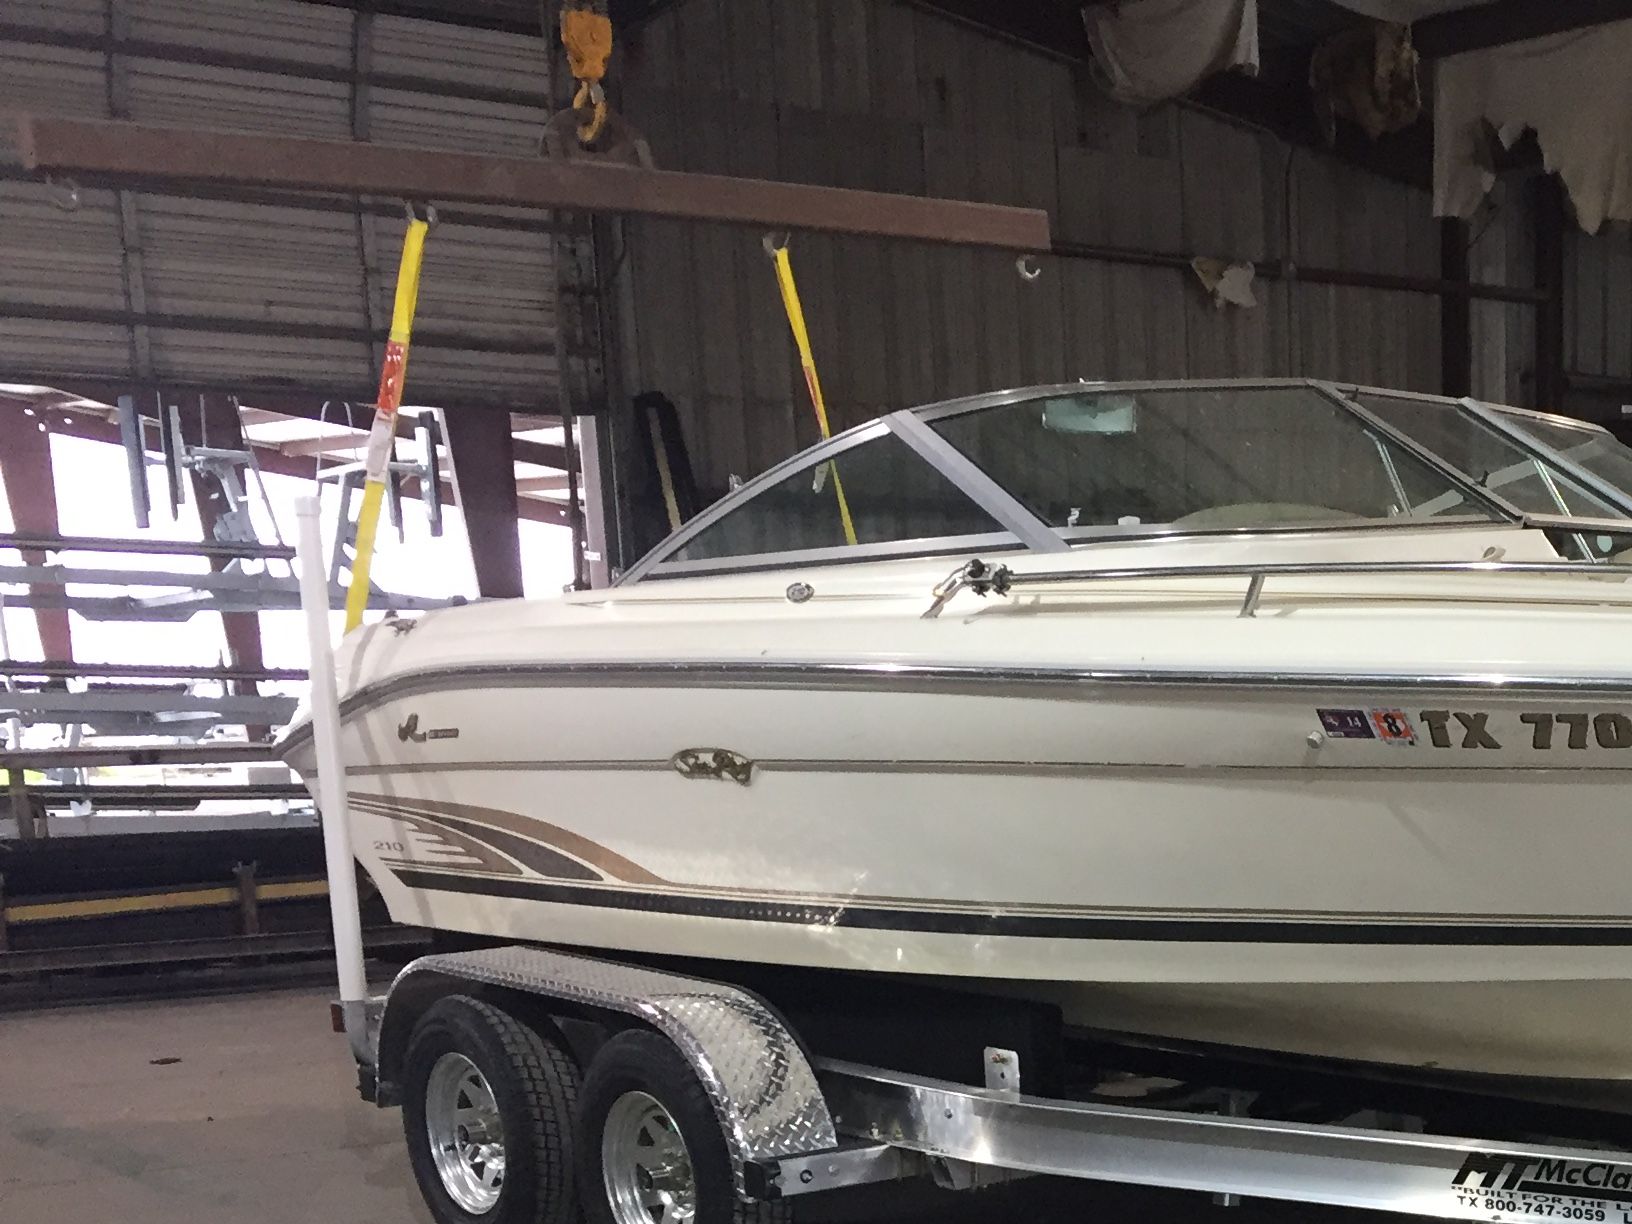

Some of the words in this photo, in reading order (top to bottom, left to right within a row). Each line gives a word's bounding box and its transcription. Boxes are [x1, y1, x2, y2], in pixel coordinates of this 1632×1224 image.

[1382, 712, 1403, 737] 8
[1419, 709, 1503, 750] TX
[373, 840, 405, 852] 210
[1456, 1195, 1479, 1208] TX
[1484, 1198, 1606, 1222] 800-747-3059
[1521, 1193, 1564, 1205] FOR
[1569, 1198, 1608, 1210] THE
